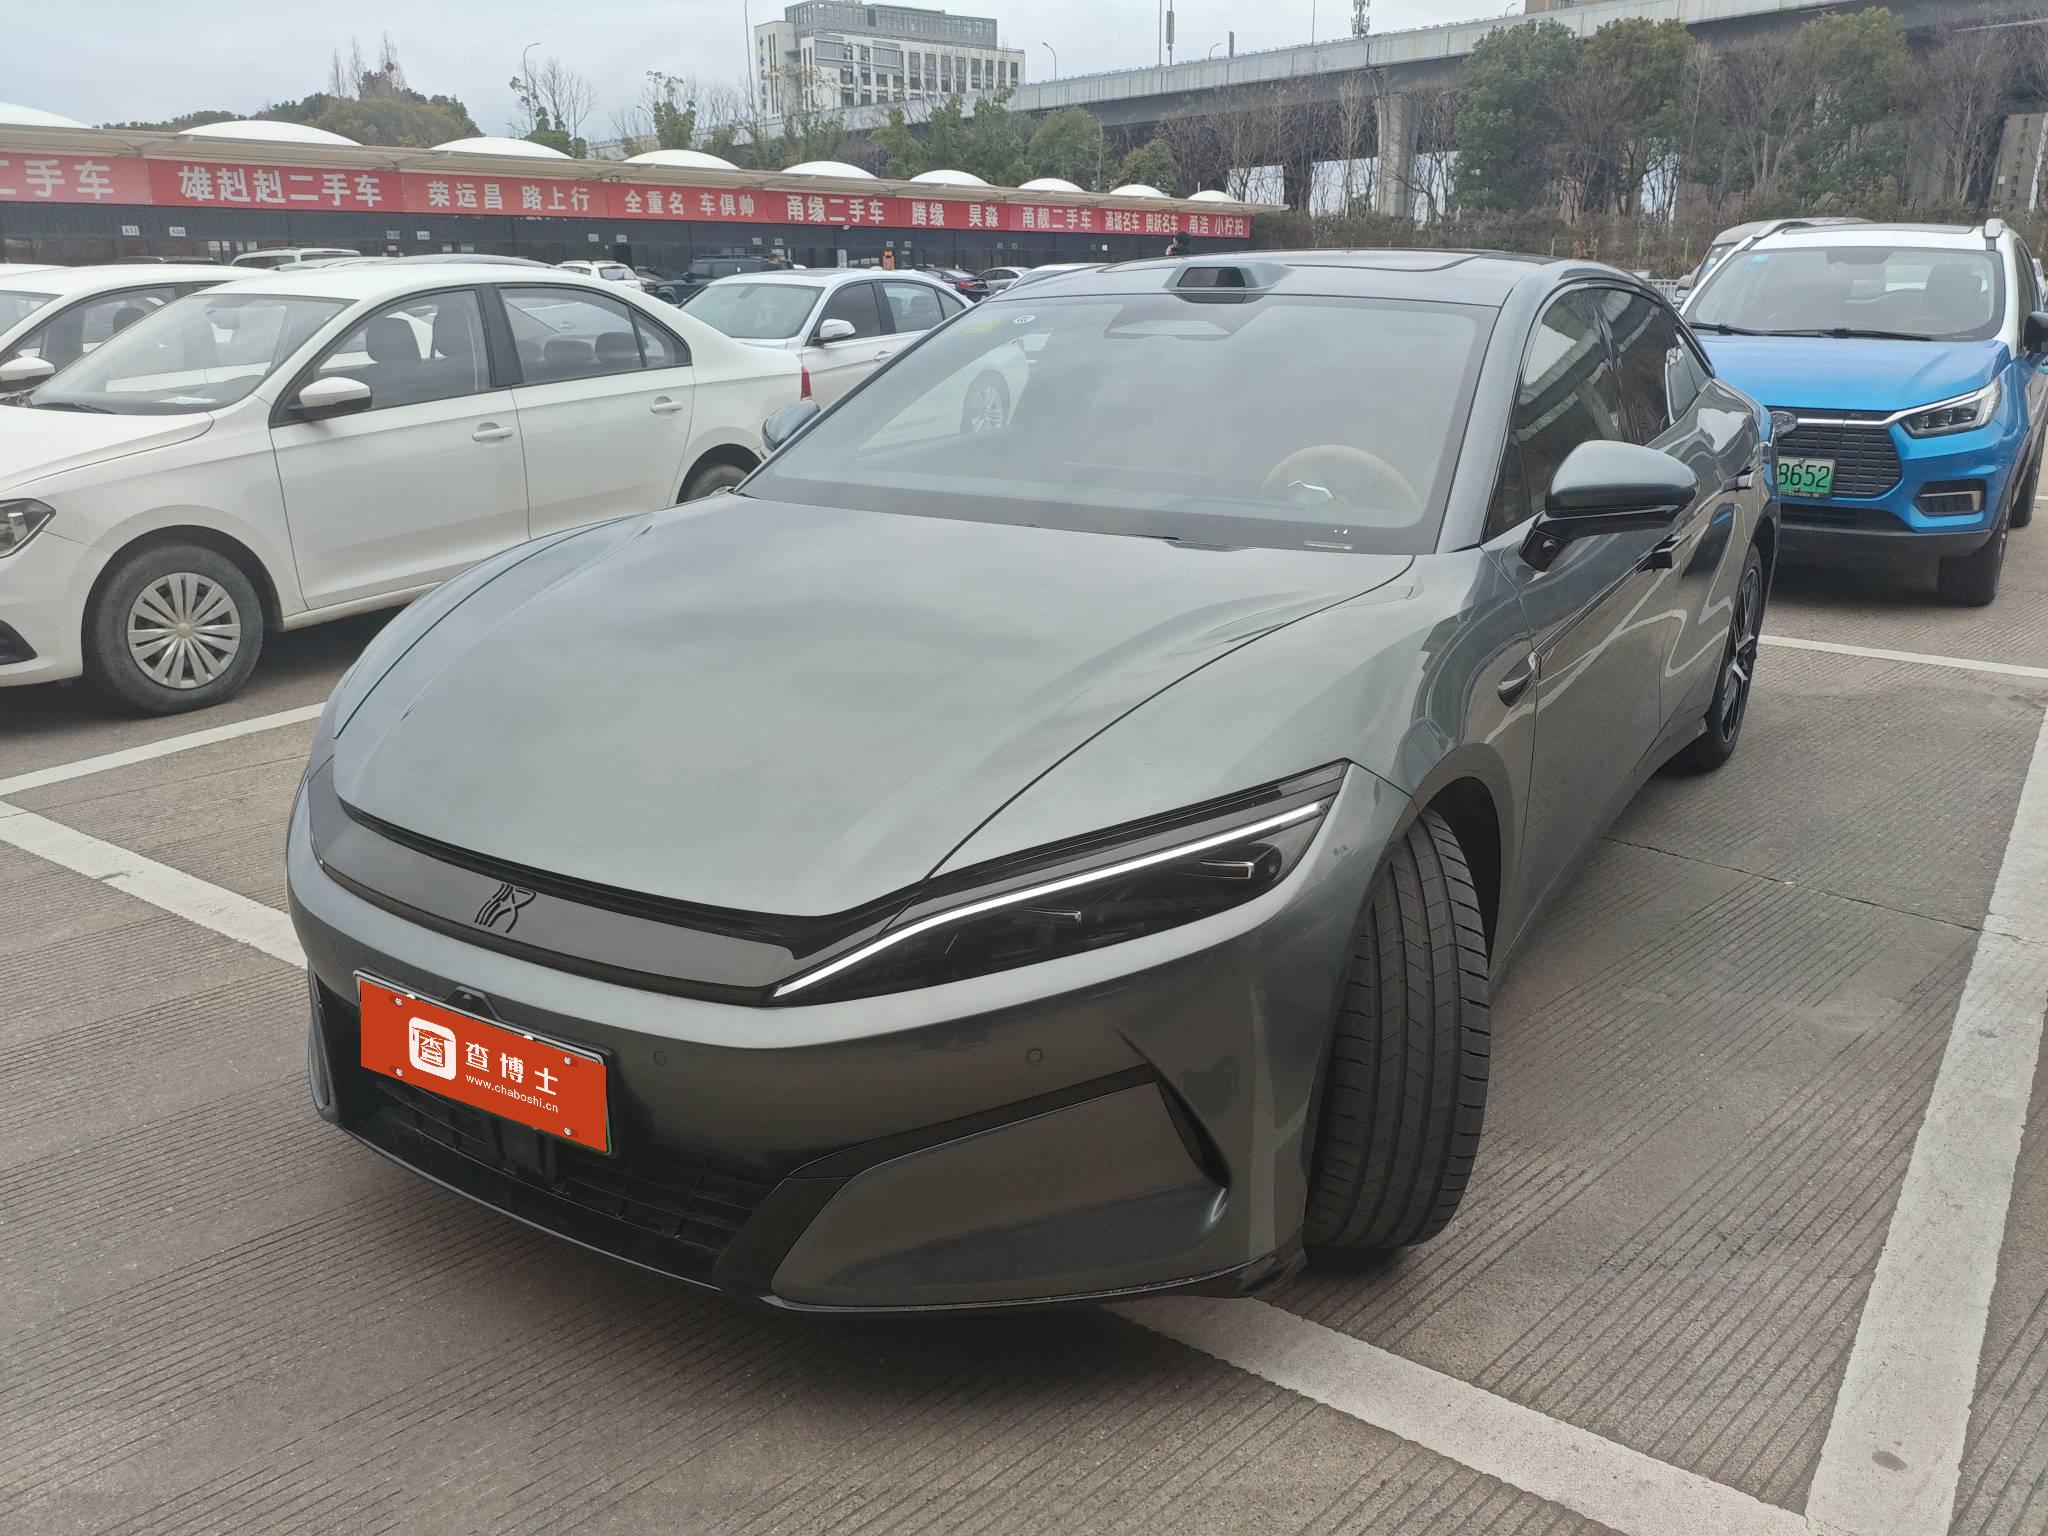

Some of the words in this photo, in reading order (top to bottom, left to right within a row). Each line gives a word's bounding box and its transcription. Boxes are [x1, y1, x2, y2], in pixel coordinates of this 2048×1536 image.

[177, 165, 383, 208] 雄赳赳二手车
[426, 180, 504, 211] 荣运昌
[521, 184, 591, 212] 路上行
[786, 194, 885, 225] 甬缘二手车
[1778, 463, 1830, 488] 8652
